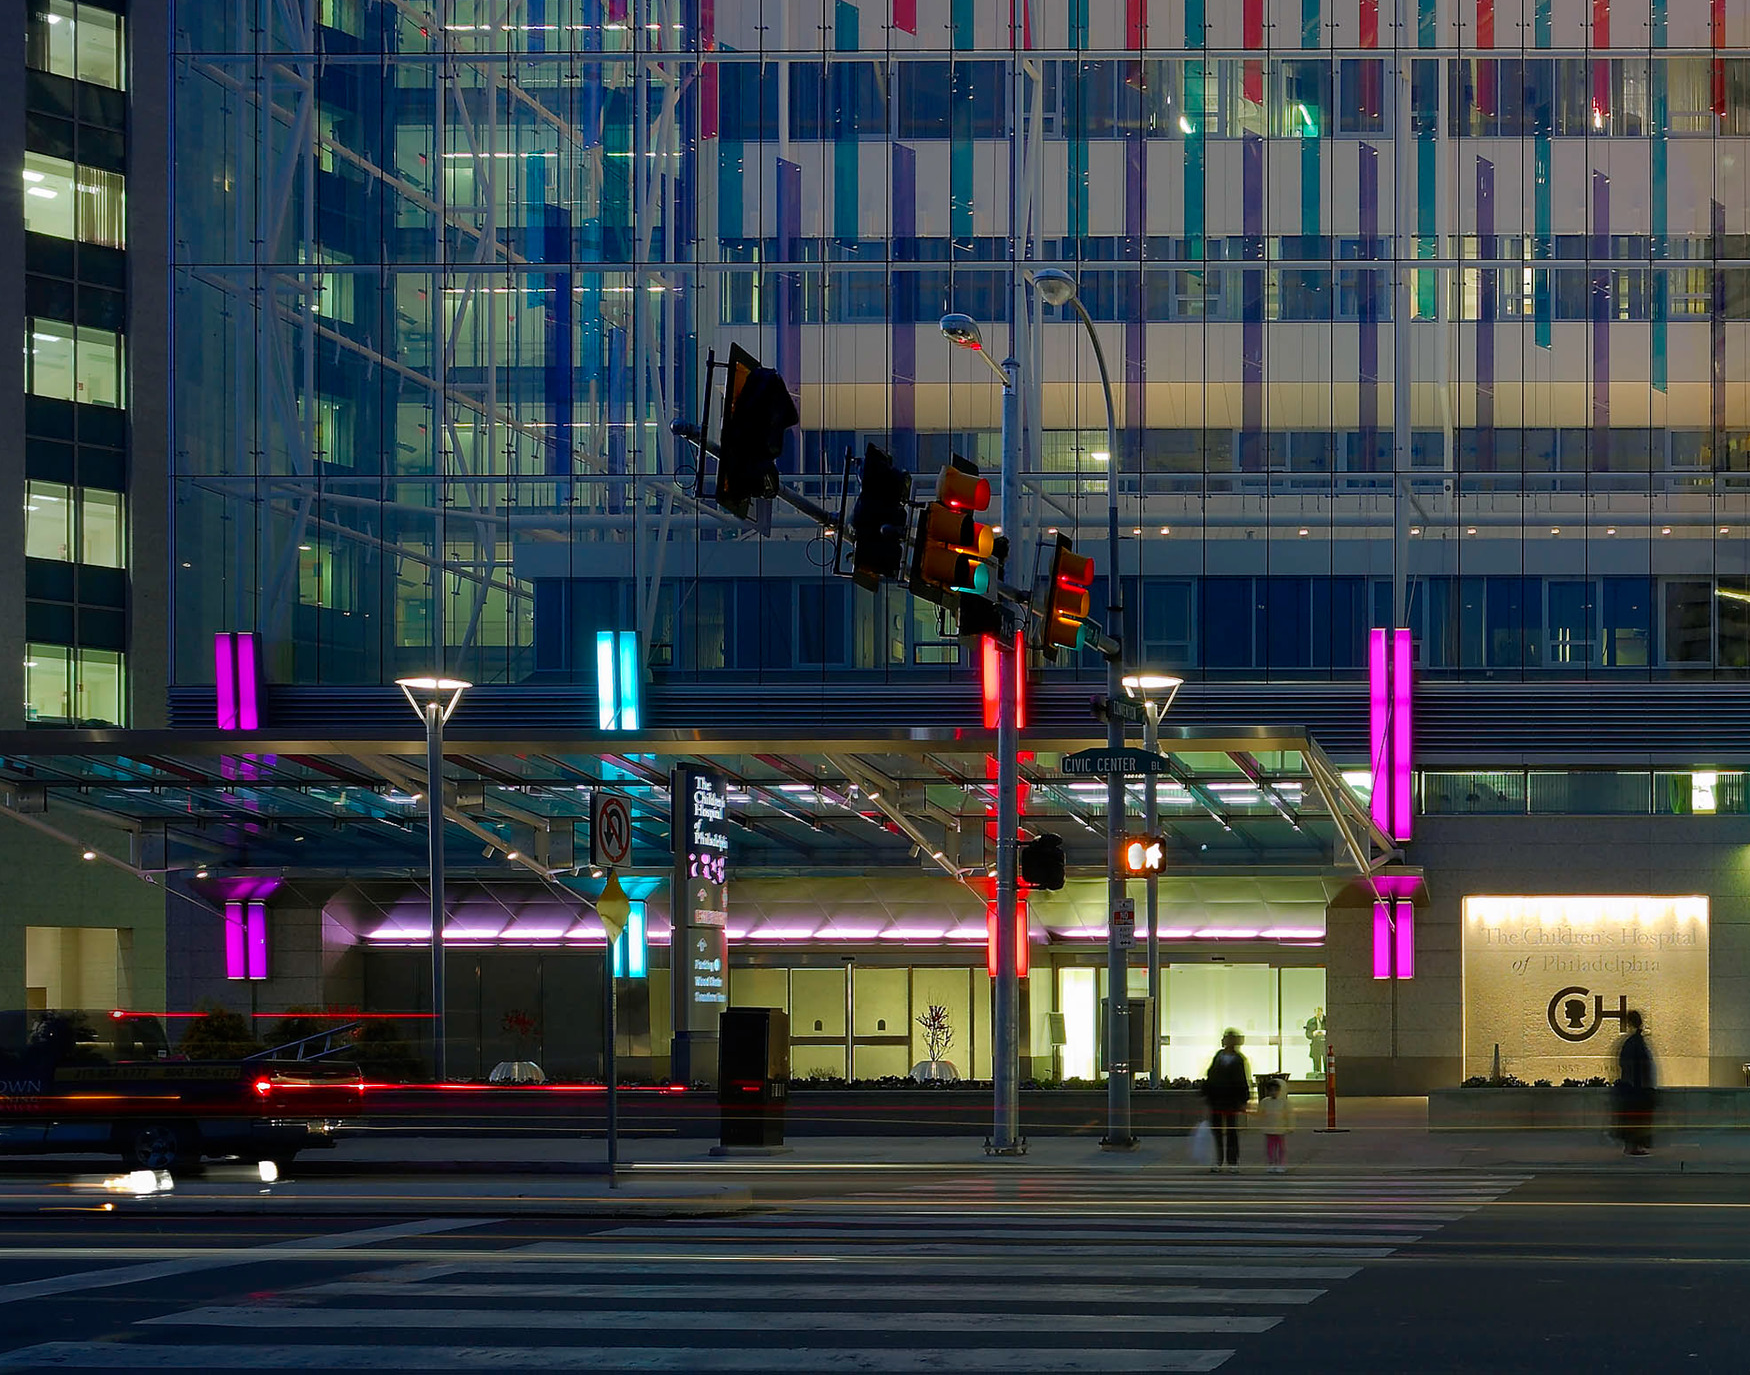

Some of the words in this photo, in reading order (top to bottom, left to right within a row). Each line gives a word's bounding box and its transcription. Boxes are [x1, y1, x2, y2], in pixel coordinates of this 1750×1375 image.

[1064, 758, 1092, 773] CIVIC
[1097, 757, 1136, 772] CENTER
[1151, 761, 1162, 771] BL
[694, 775, 713, 792] The
[1481, 927, 1517, 945] The
[1523, 926, 1614, 946] Children's
[1621, 926, 1697, 951] Hospital
[1512, 956, 1530, 975] of
[1542, 954, 1661, 976] Philadelphia
